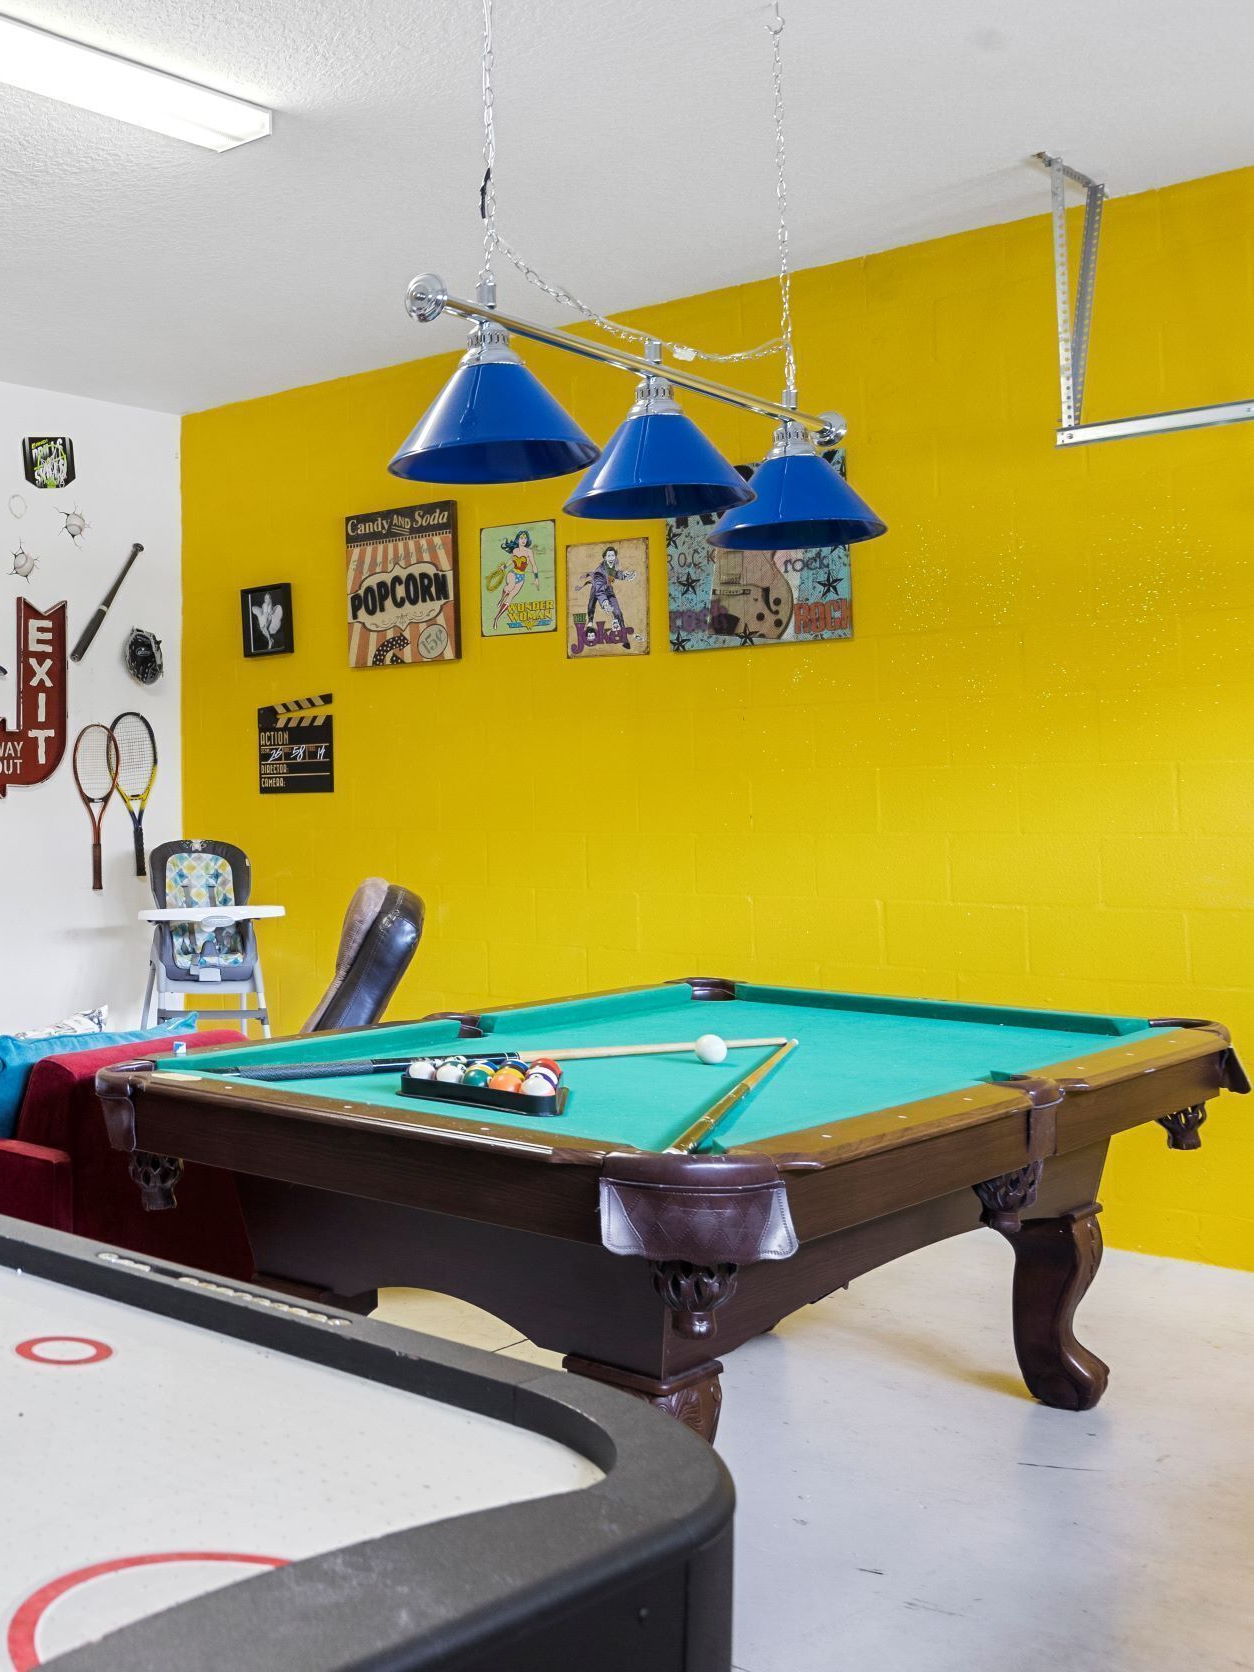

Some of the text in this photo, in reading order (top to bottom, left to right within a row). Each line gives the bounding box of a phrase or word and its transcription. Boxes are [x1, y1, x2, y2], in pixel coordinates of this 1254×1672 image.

[347, 509, 448, 536] Candy AND Soda
[783, 548, 830, 573] rock
[350, 571, 451, 621] POPCORN
[508, 599, 554, 613] WONDER
[507, 609, 553, 622] WOMAN
[572, 613, 587, 622] THE
[571, 621, 634, 654] Joker
[28, 618, 55, 764] EXIT
[260, 731, 289, 746] ACTION
[260, 764, 289, 774] DIRECTOR:
[261, 777, 287, 788] CAMERA:
